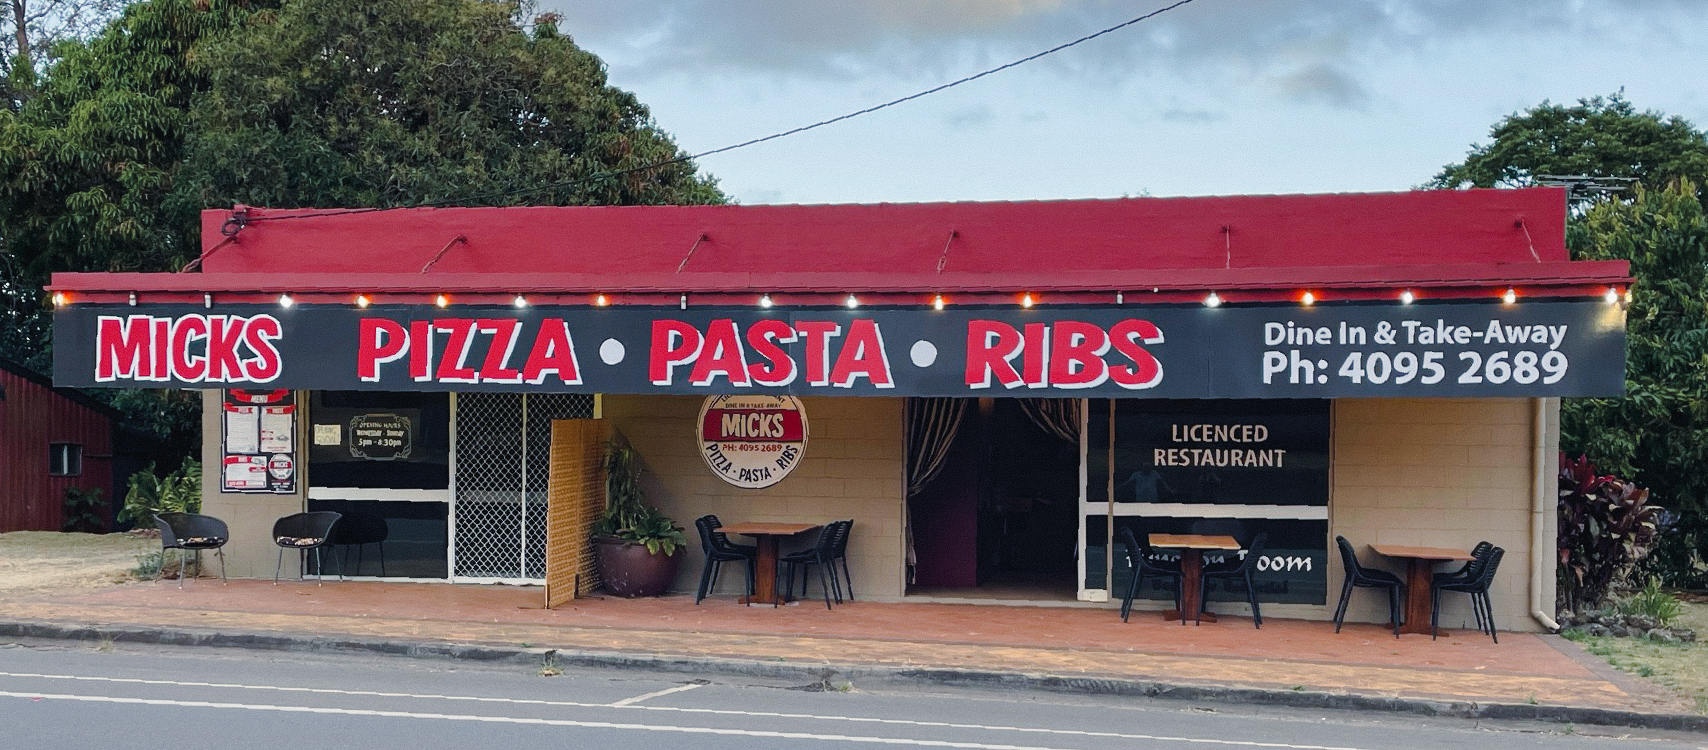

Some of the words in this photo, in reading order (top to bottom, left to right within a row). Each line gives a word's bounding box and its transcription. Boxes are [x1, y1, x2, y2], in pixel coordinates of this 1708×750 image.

[95, 313, 283, 383] MICKS
[1264, 320, 1332, 346] Dine
[1339, 321, 1367, 346] In
[1373, 320, 1397, 345] &
[1402, 319, 1568, 350] Take-Away
[357, 318, 583, 386] PIZZA
[649, 318, 896, 389] PASTA
[965, 318, 1165, 390] RIBS
[1262, 350, 1328, 385] Ph:
[1338, 350, 1445, 385] 4095
[1457, 350, 1569, 385] 2689
[721, 412, 785, 438] MICKS
[1172, 423, 1269, 443] LICENCED
[358, 438, 373, 447] 5pm
[722, 443, 737, 452] PH:
[739, 443, 760, 452] 4095
[760, 443, 783, 453] 2689
[706, 443, 732, 473] PIZZA
[739, 466, 772, 483] PASTA
[776, 444, 798, 470] RIBS
[1154, 448, 1287, 468] RESTAURANT
